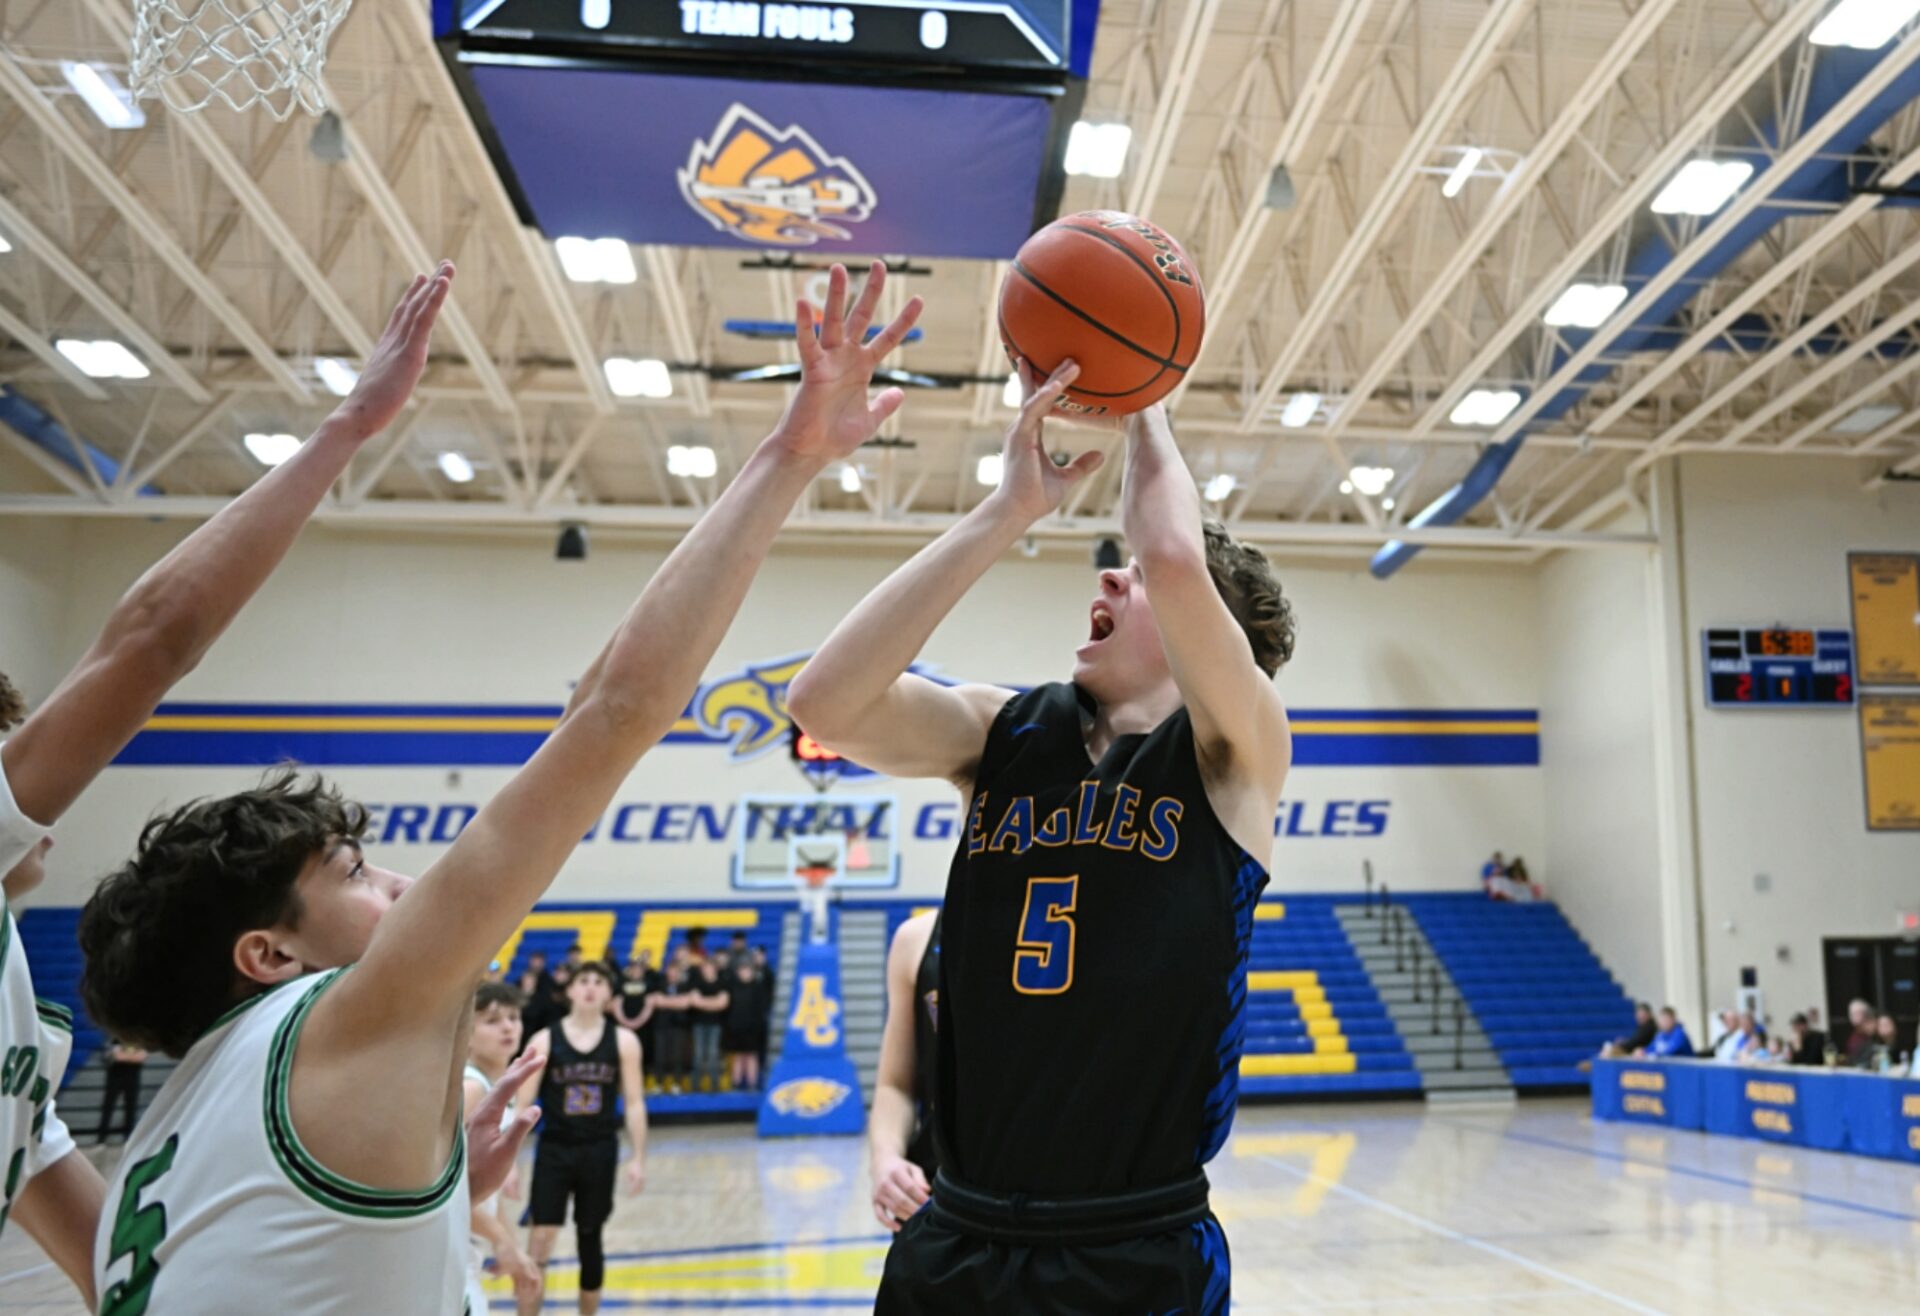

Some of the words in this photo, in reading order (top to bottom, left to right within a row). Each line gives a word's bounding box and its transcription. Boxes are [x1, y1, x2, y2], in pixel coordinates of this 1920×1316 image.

[679, 0, 760, 37] TEAM
[763, 4, 854, 43] FOULS
[920, 10, 948, 50] 0
[610, 803, 892, 841] CENTRAL
[1012, 874, 1079, 995] 5
